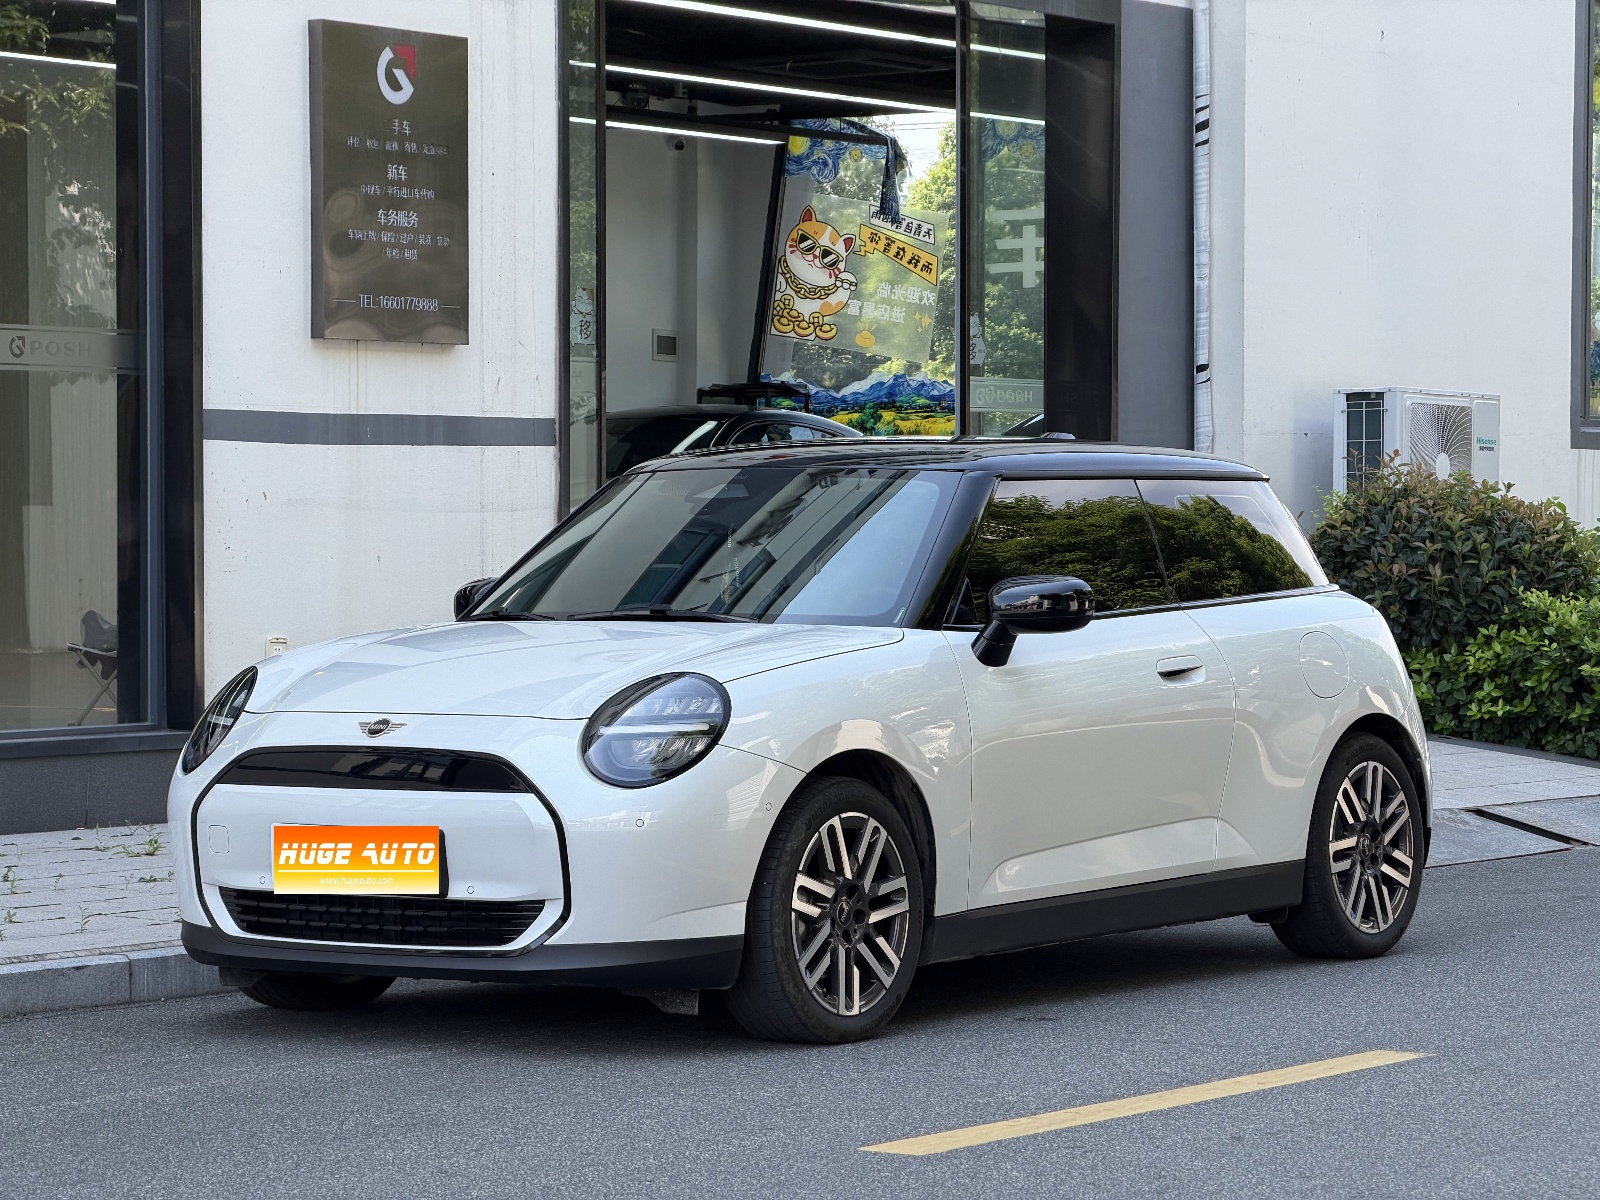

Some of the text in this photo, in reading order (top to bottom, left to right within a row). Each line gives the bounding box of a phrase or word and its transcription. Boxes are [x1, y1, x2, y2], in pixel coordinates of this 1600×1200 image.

[387, 164, 408, 181] 新车
[377, 208, 419, 227] 车务服务
[381, 231, 395, 243] 保险
[400, 233, 414, 244] 过户
[386, 247, 418, 260] 年检 租赁
[30, 340, 91, 357] POSH
[1476, 436, 1497, 446] Hisense
